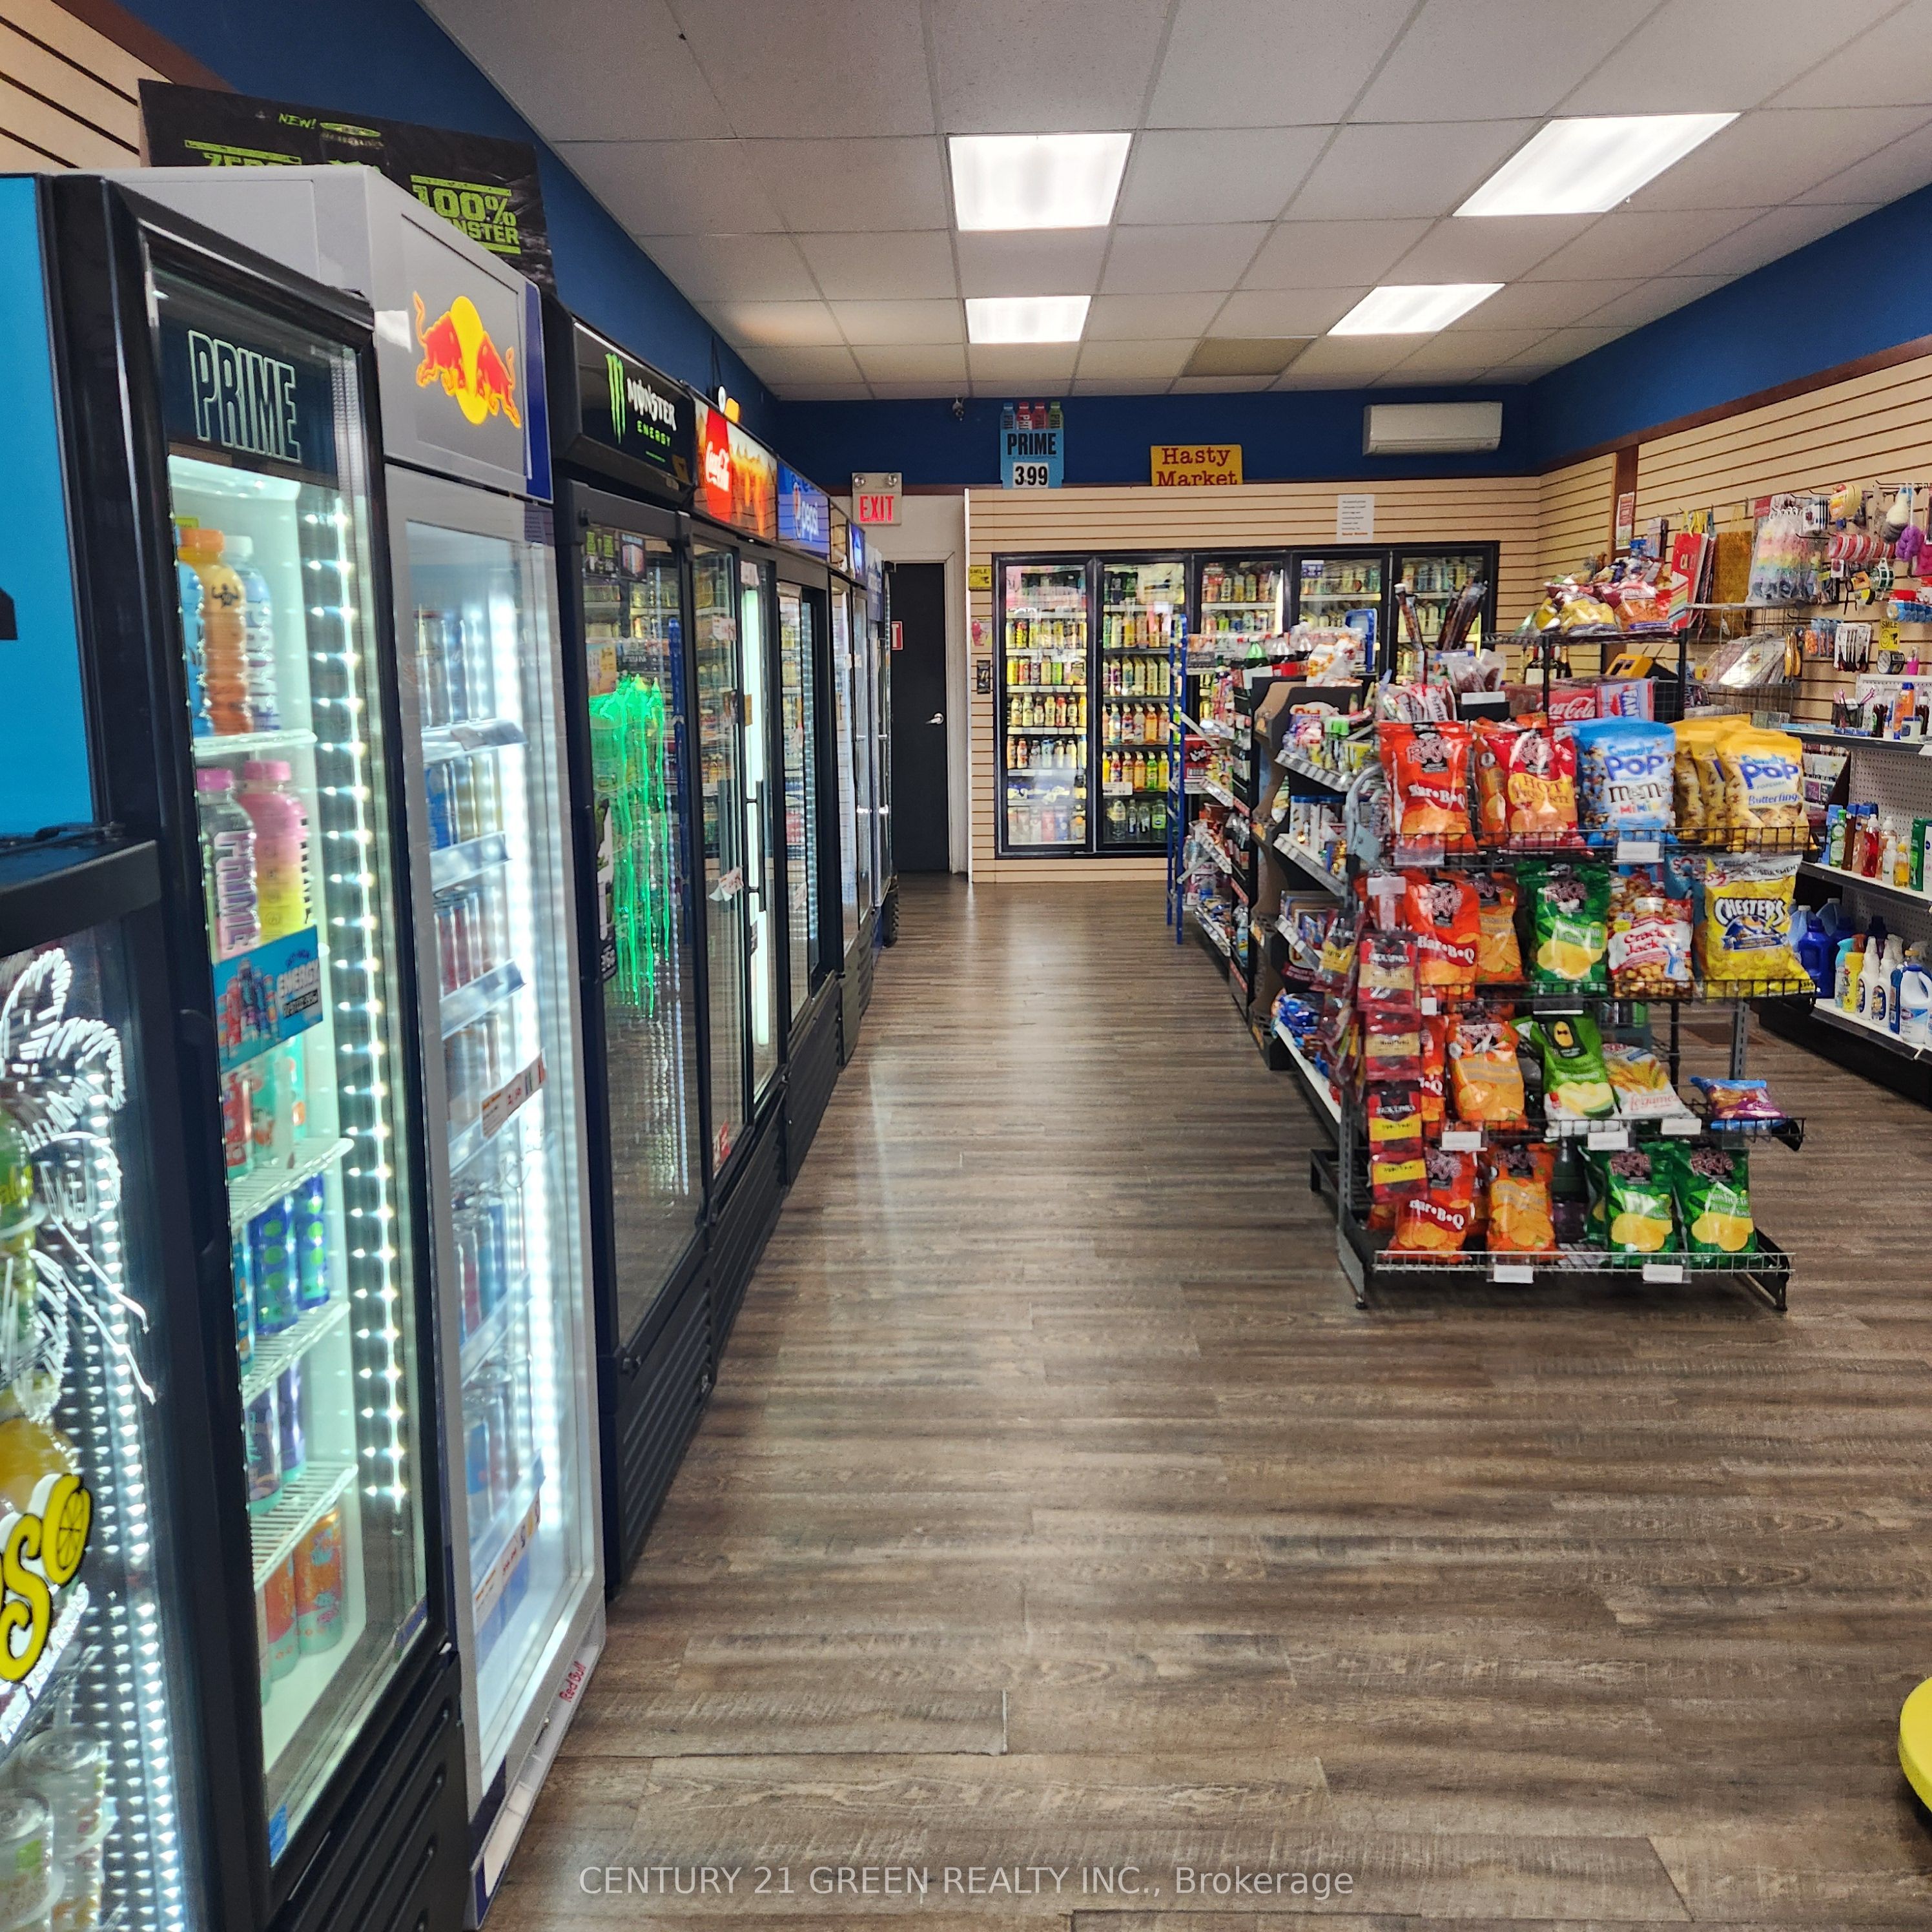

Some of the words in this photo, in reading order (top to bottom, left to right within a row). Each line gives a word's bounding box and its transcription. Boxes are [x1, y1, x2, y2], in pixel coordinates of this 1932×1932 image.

[279, 113, 317, 129] NEW!
[412, 185, 517, 226] 100%
[446, 218, 520, 245] NSTER
[188, 330, 302, 464] PRIME
[626, 377, 677, 431] MONSTER
[637, 420, 671, 447] ENERGY
[1007, 433, 1056, 455] PRIME
[1162, 447, 1231, 467] Hasty
[1156, 470, 1238, 486] Market
[801, 500, 819, 542] pepsi
[859, 495, 894, 522] EXIT
[1715, 898, 1787, 926] CHESTER'S
